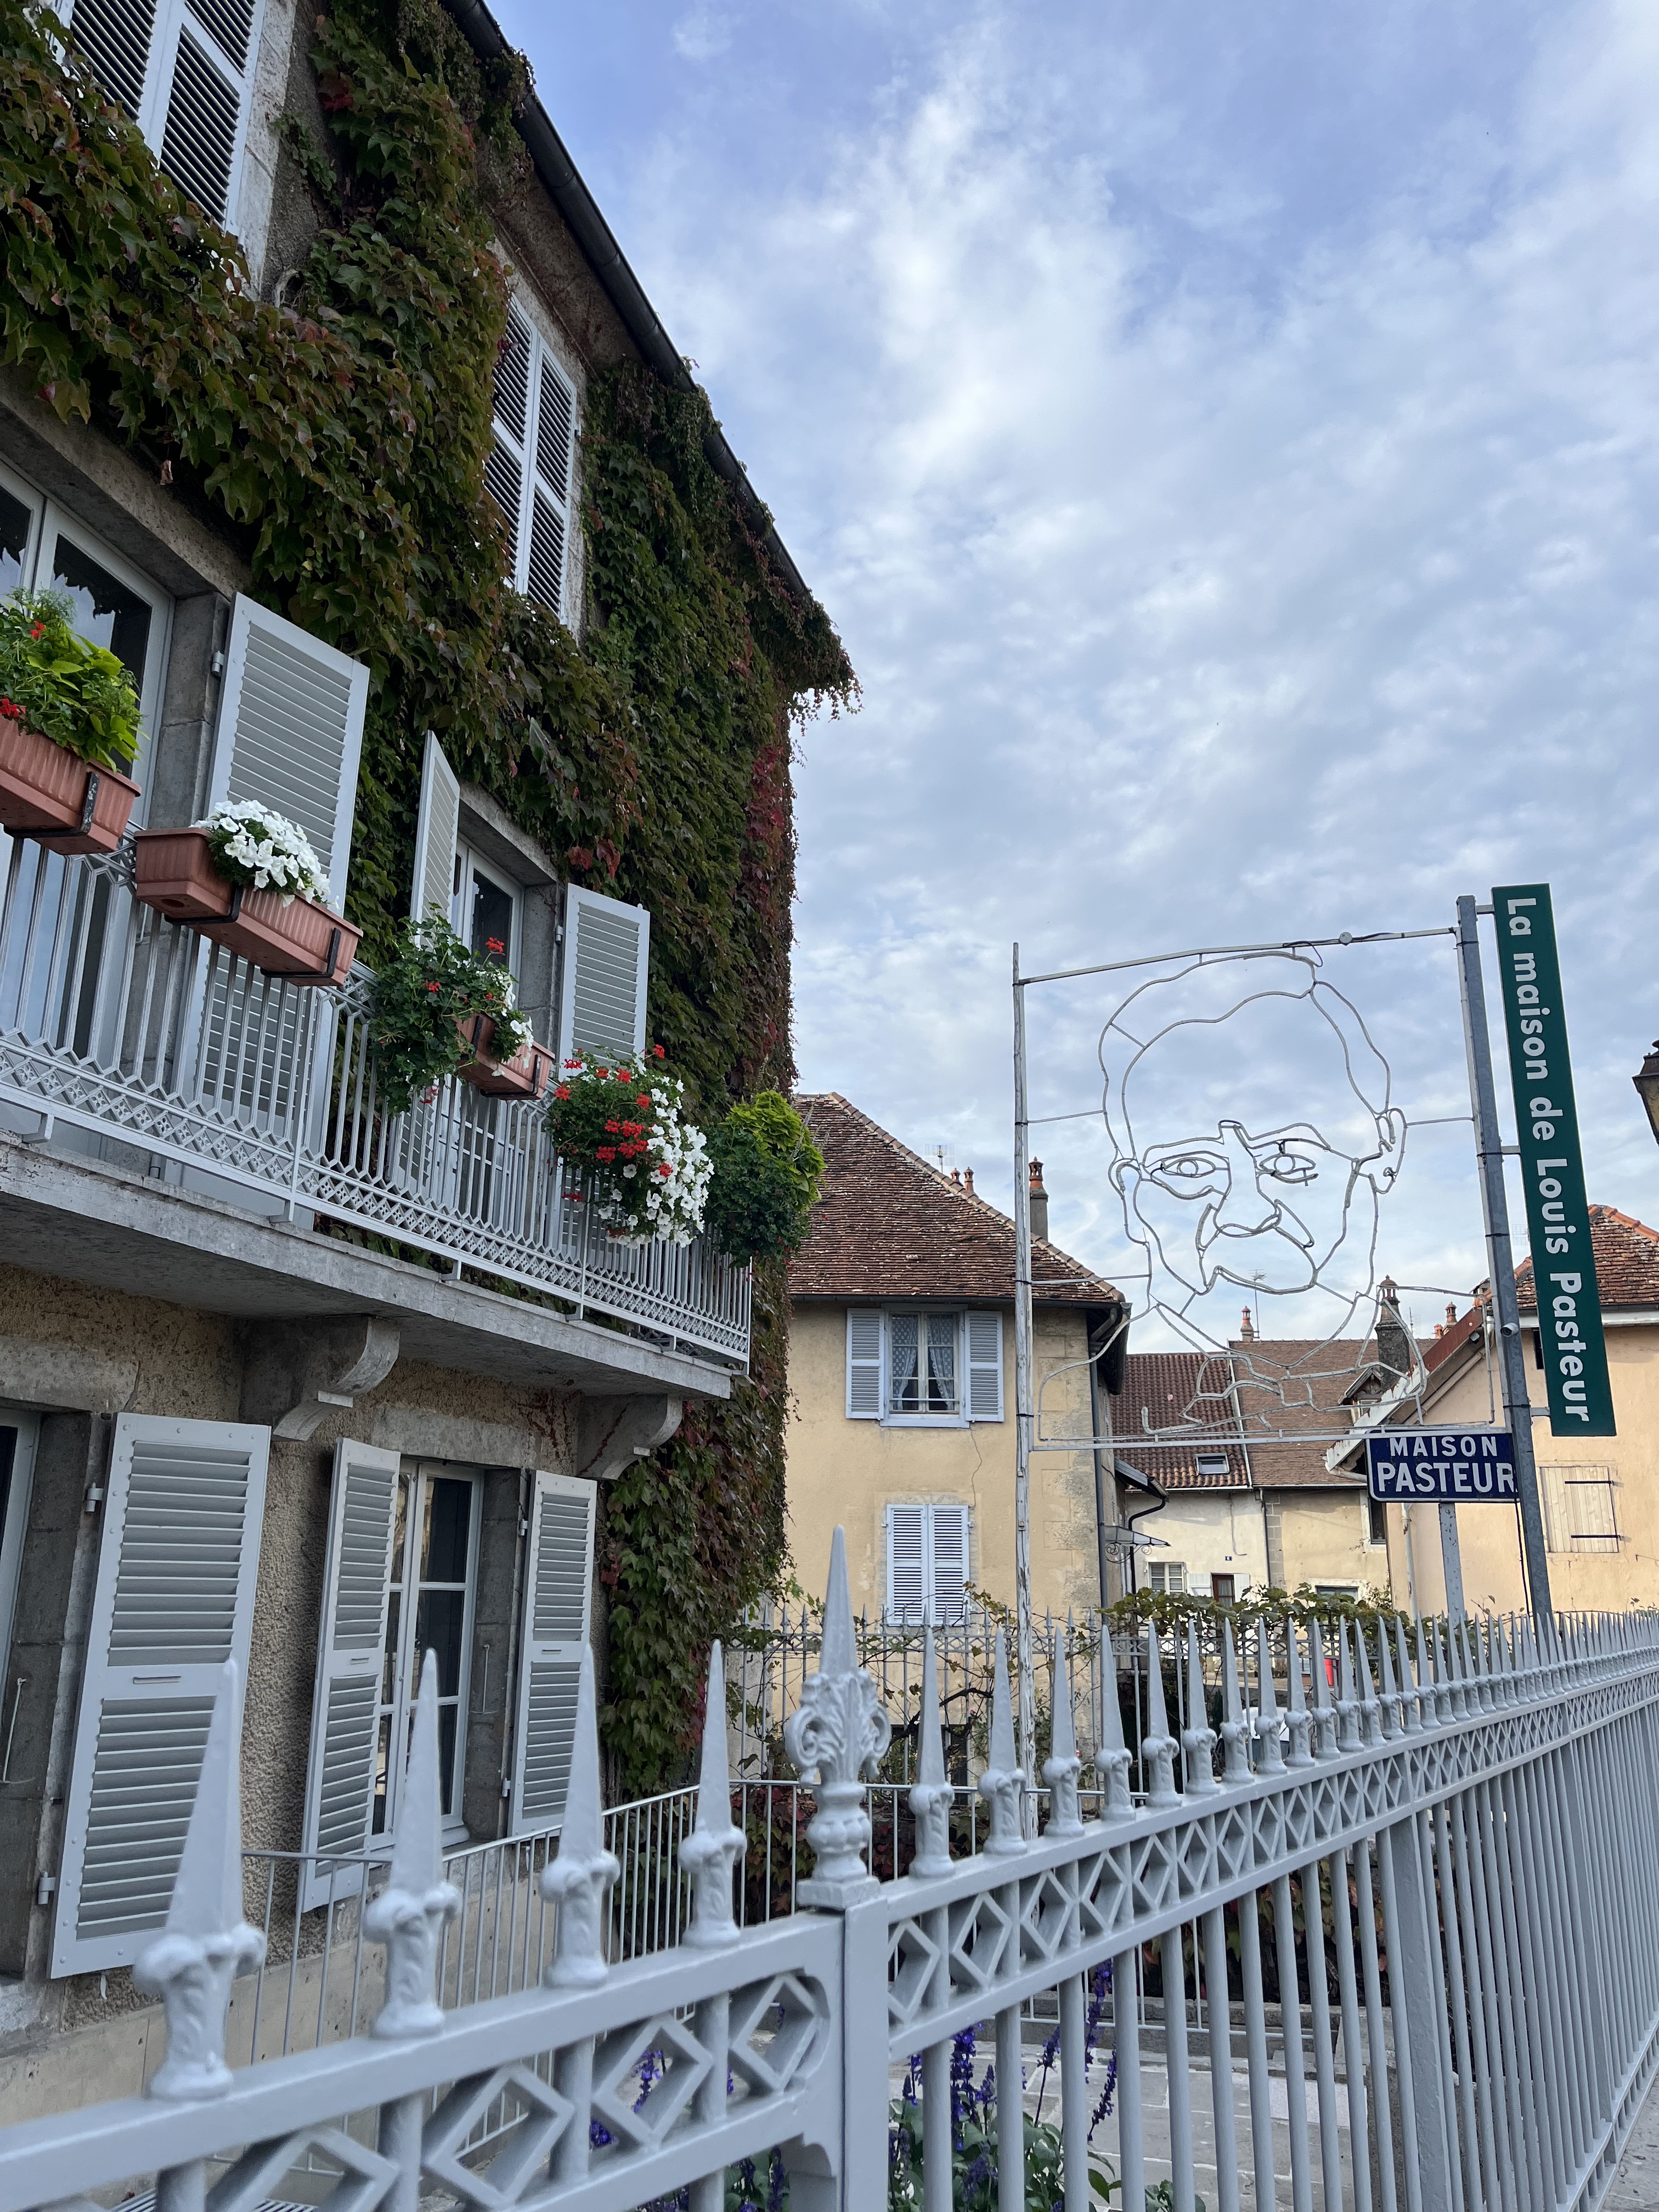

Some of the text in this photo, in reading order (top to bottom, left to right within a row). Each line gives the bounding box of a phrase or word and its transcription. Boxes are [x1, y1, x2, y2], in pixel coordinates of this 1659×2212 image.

[1507, 898, 1590, 1422] La maison de Louis Pasteur
[1390, 1436, 1498, 1457] MAISON
[1377, 1462, 1519, 1493] PASTEUR
